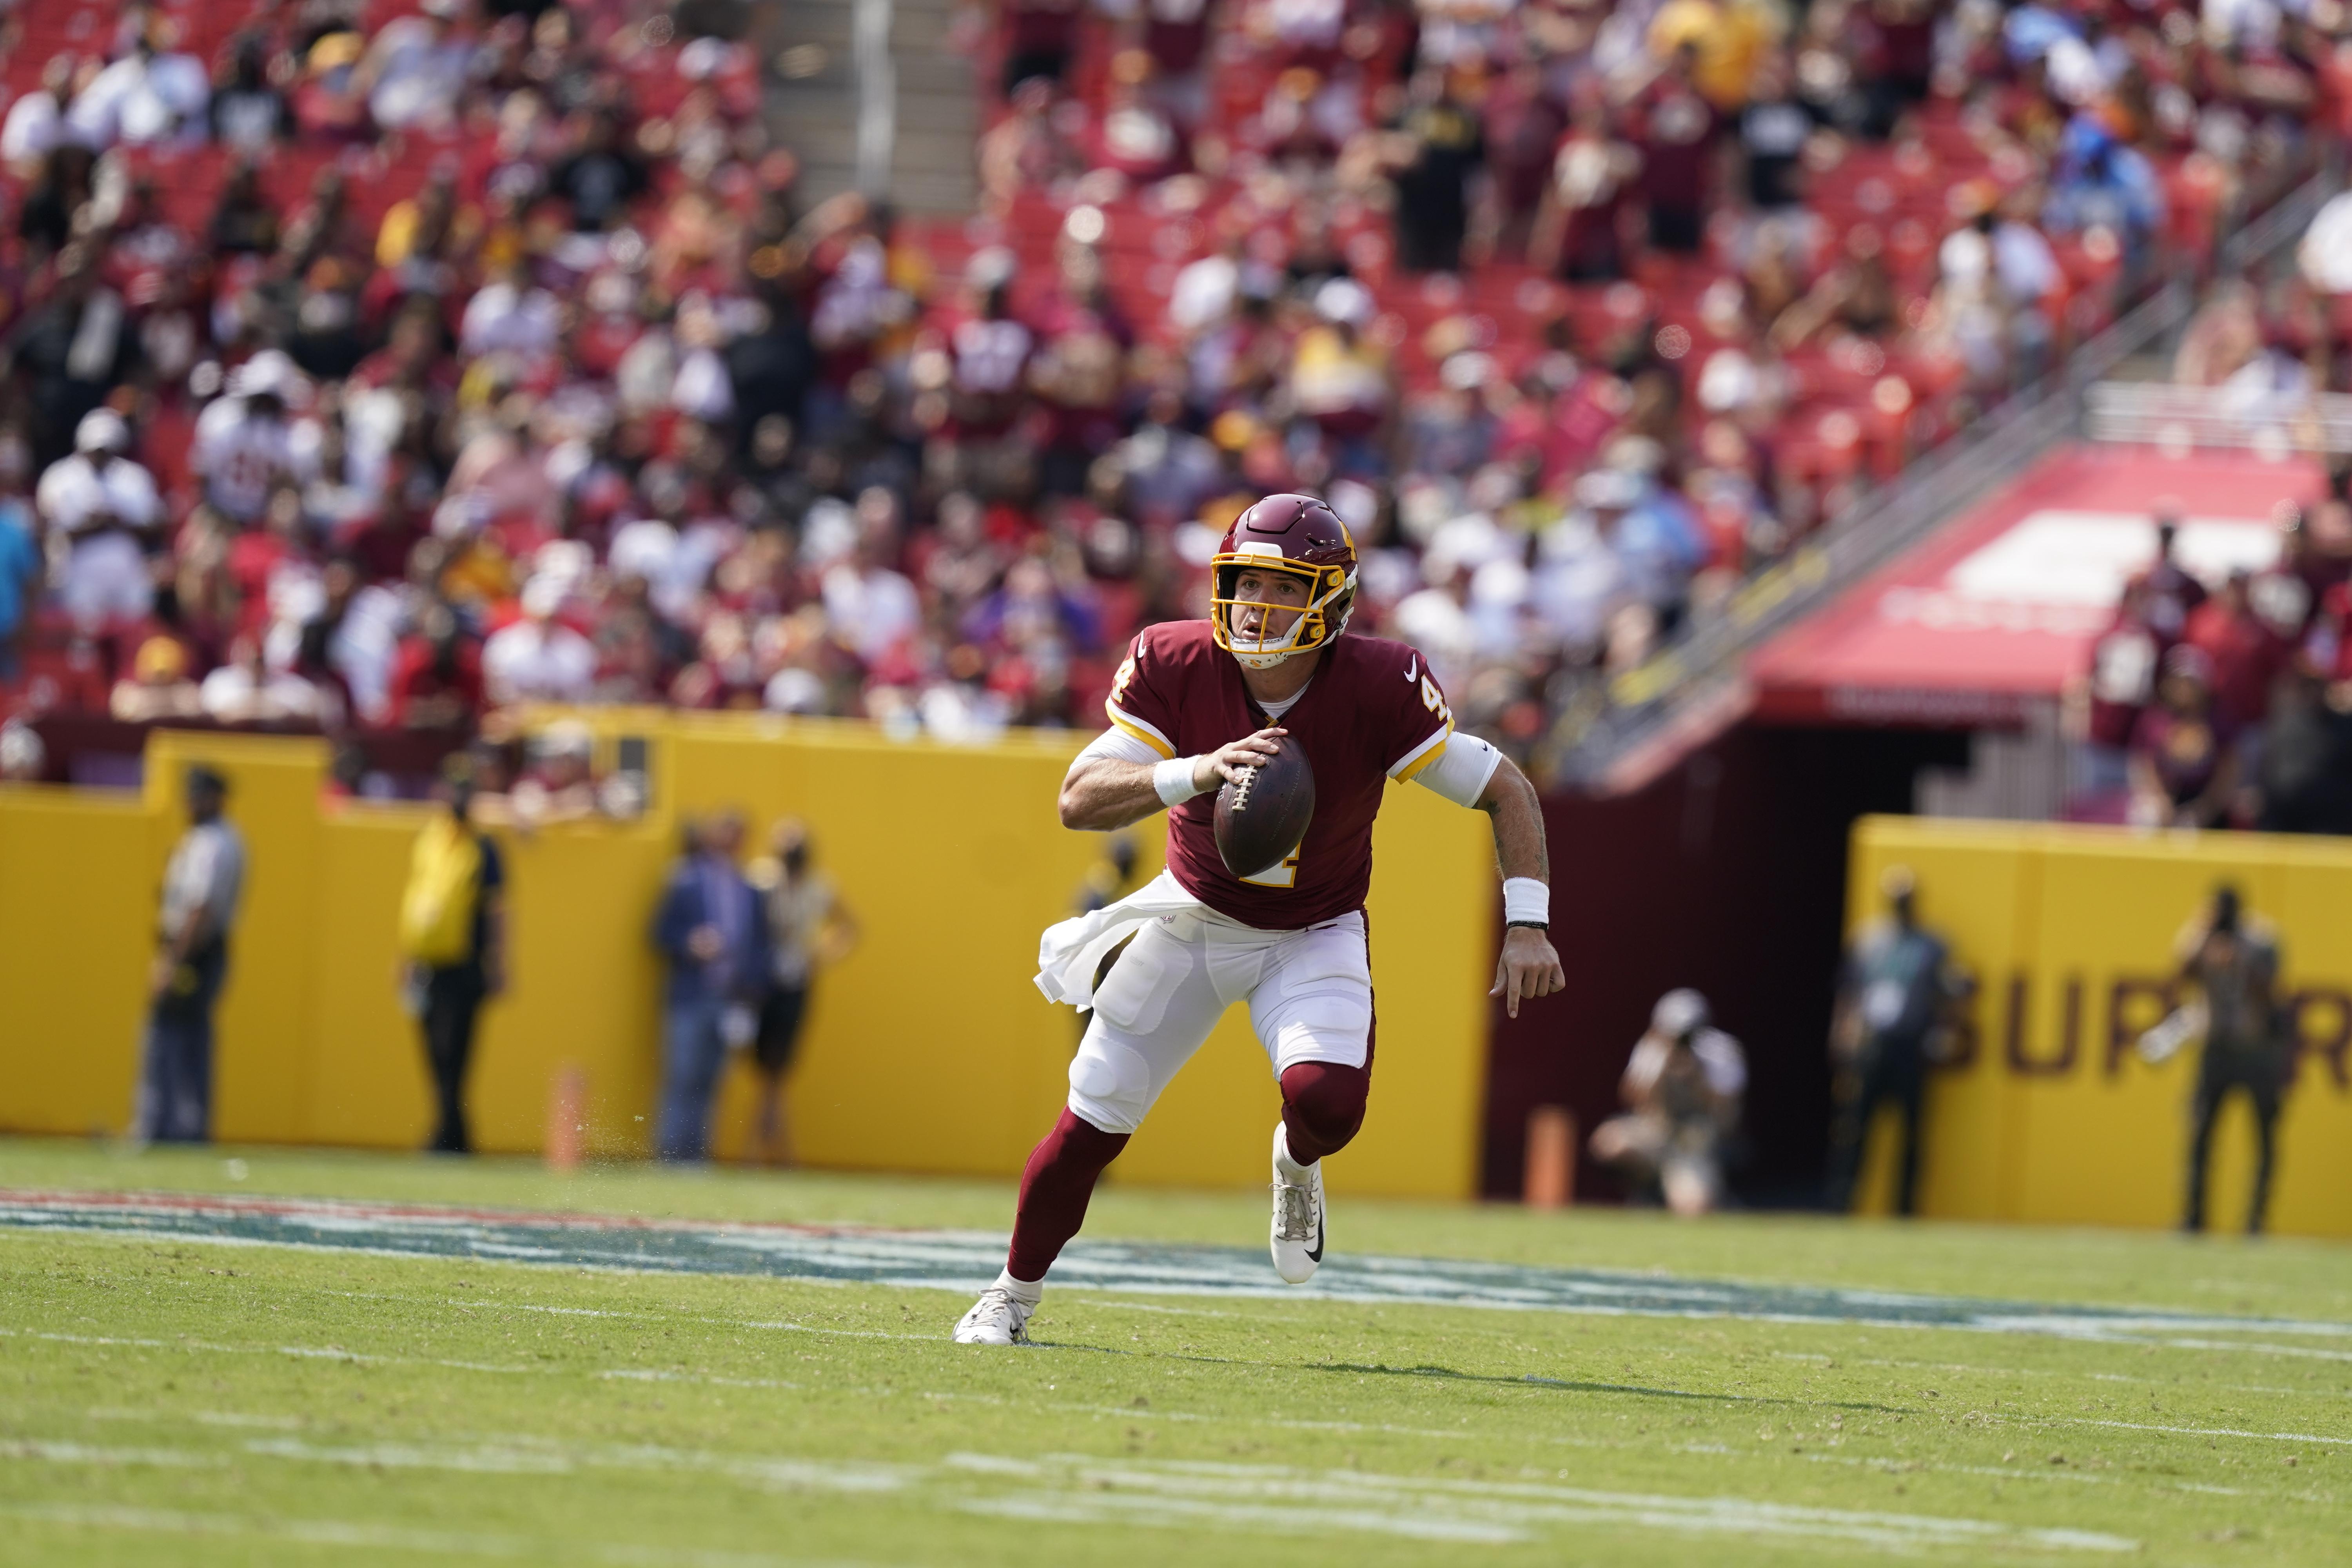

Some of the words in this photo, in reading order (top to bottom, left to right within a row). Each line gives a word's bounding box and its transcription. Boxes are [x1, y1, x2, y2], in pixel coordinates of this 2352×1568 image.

[1112, 653, 1136, 704] 4
[1421, 673, 1448, 722] 4
[1270, 813, 1287, 841] NATIONAL
[1285, 782, 1298, 811] FOOTBALL
[1931, 970, 2352, 1090] UPR
